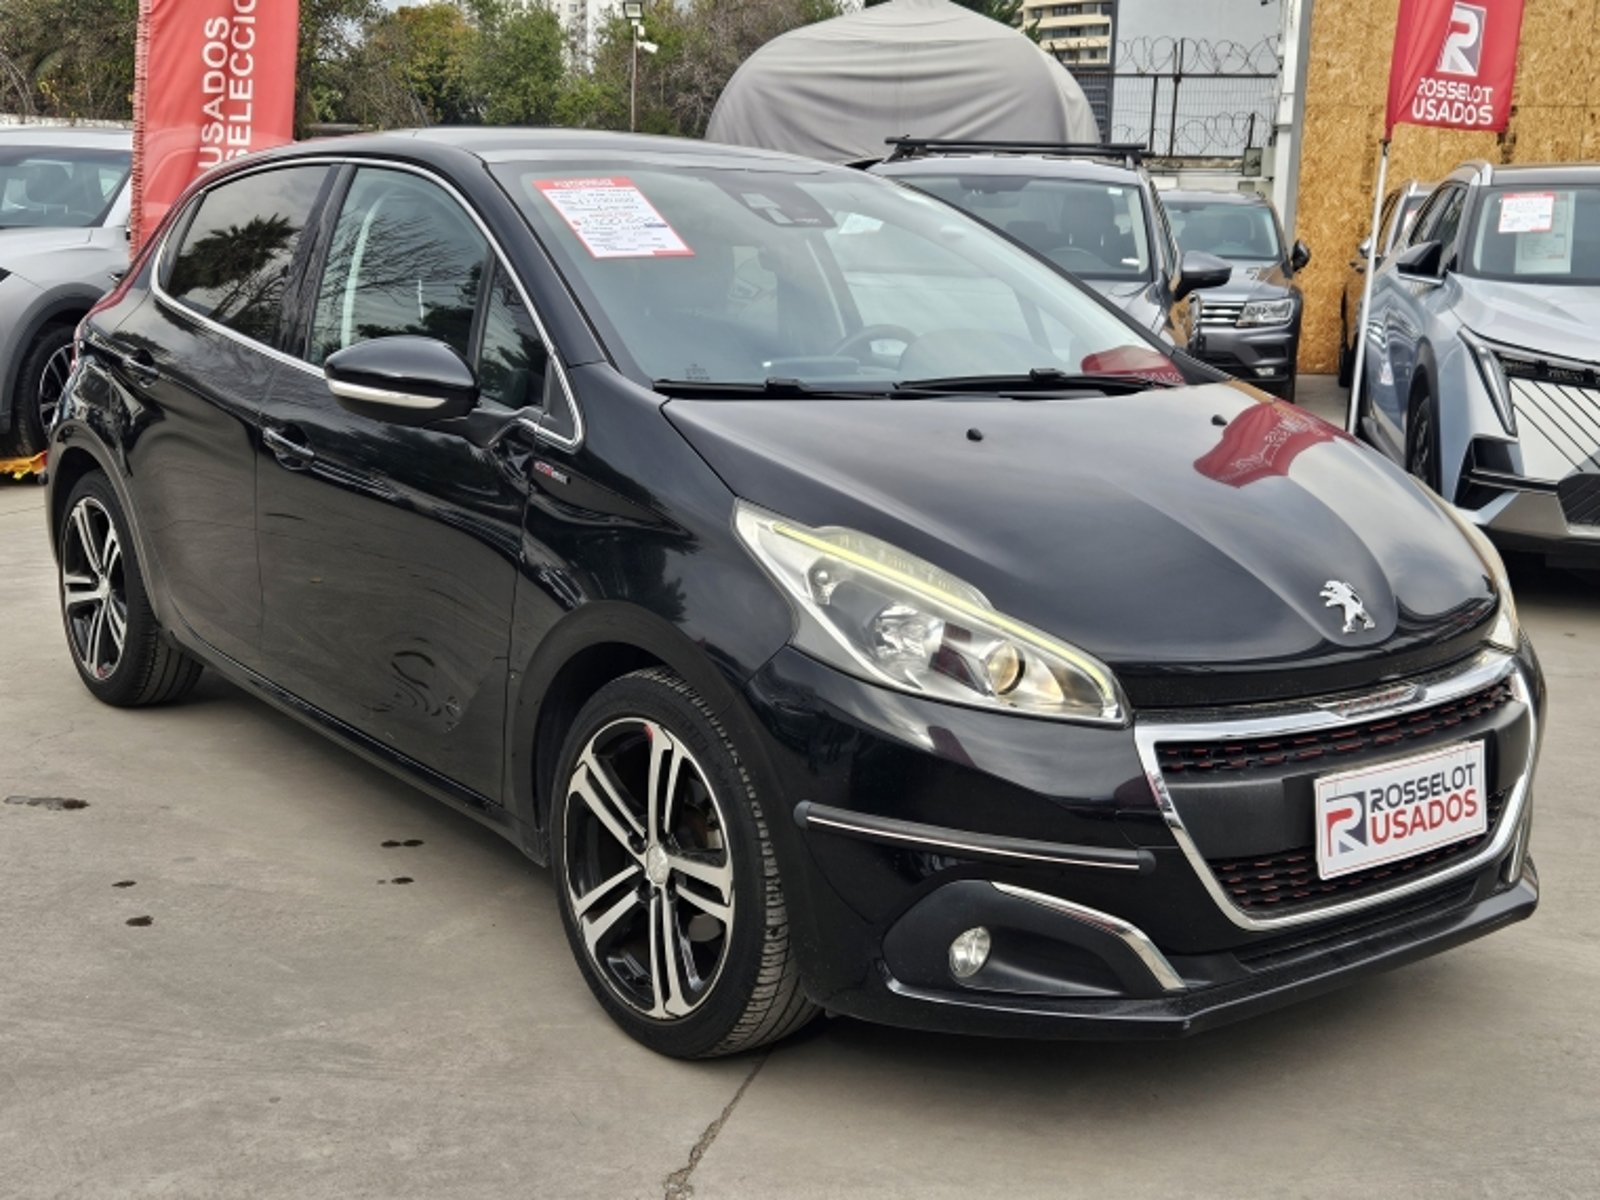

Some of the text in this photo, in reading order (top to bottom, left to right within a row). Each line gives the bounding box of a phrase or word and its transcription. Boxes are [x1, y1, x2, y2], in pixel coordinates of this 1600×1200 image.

[198, 16, 230, 168] USADOS
[1412, 97, 1493, 125] USADOS
[1417, 78, 1493, 104] ROSSELOT
[1370, 763, 1476, 813] ROSSELOT
[1371, 788, 1478, 845] USADOS
